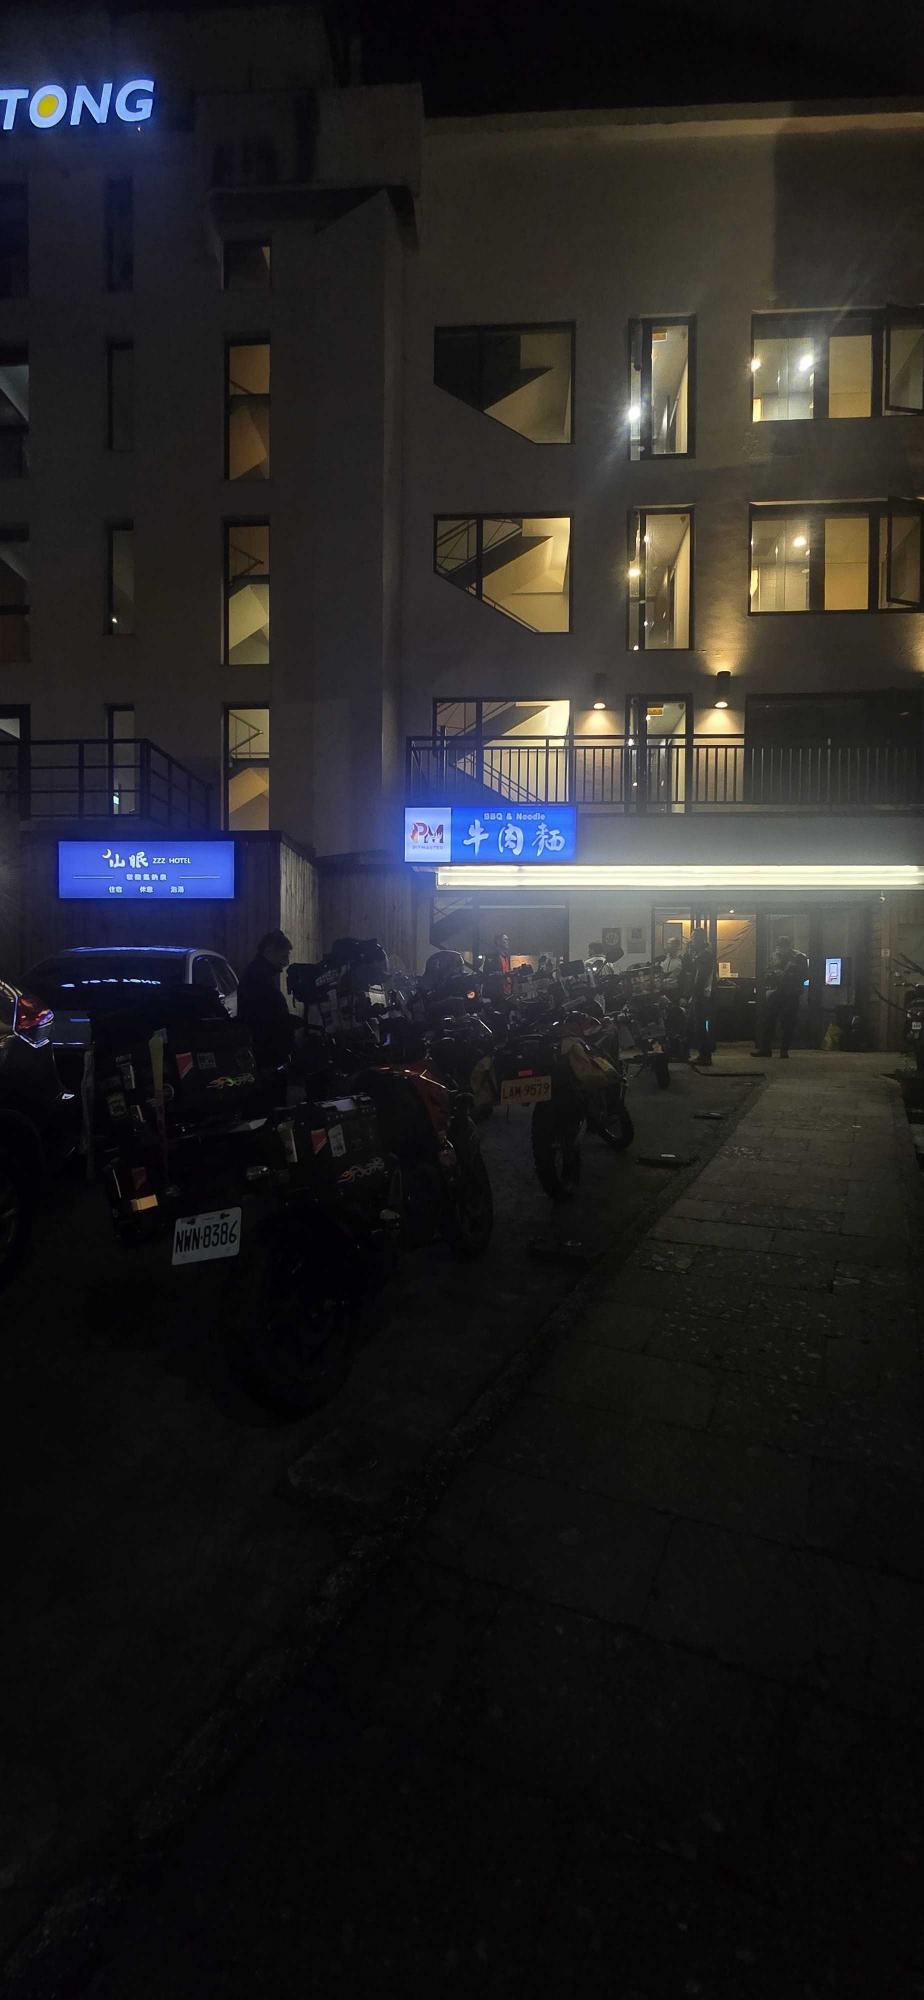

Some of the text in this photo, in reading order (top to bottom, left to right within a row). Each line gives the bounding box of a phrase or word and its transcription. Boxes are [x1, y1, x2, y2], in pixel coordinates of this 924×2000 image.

[0, 79, 154, 130] TONG
[483, 812, 546, 822] BBQ & Noodle
